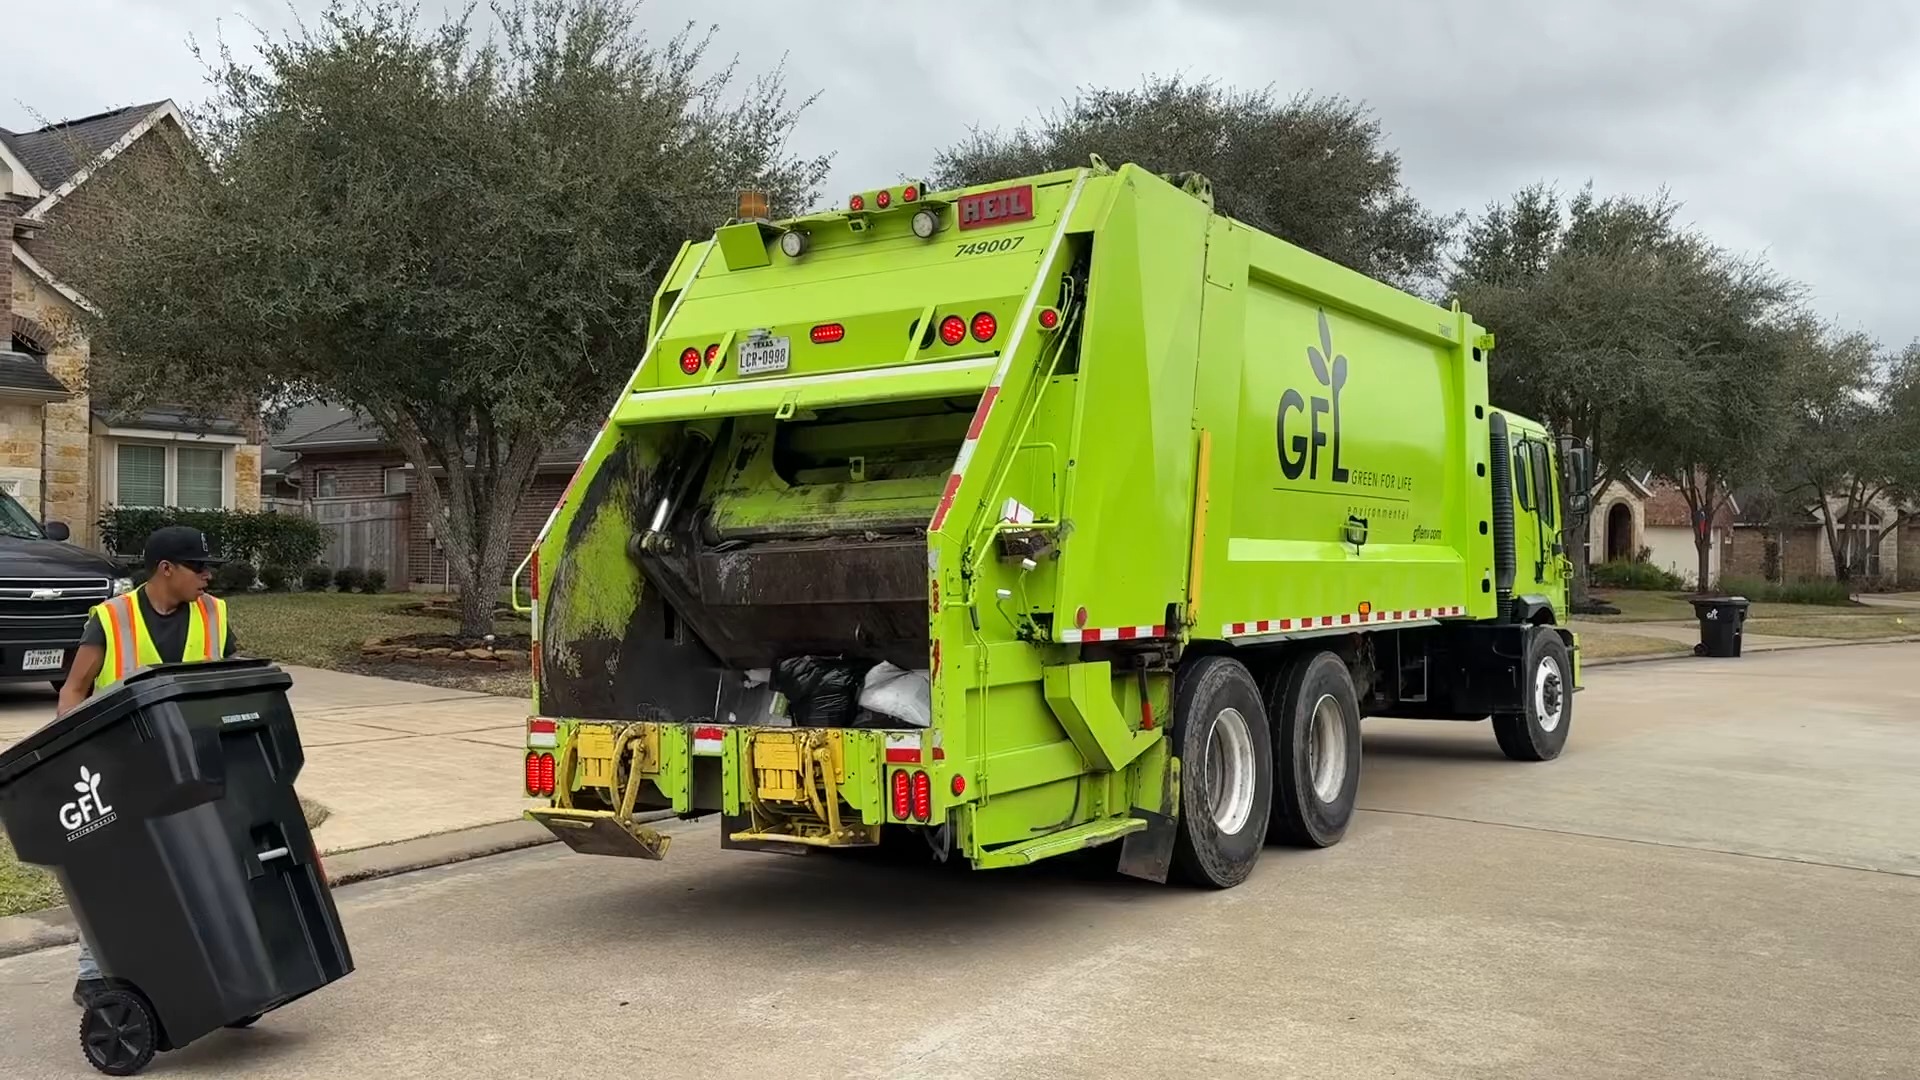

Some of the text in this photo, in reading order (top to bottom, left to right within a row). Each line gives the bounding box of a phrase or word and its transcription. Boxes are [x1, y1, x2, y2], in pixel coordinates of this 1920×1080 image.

[962, 192, 1026, 223] HEIL
[954, 236, 1025, 258] 749007
[752, 340, 774, 349] TEXAS
[1276, 354, 1350, 483] GFL
[1351, 469, 1412, 491] GREEN FOR LIFE
[1347, 506, 1409, 520] environmental
[59, 771, 113, 830] GFL
